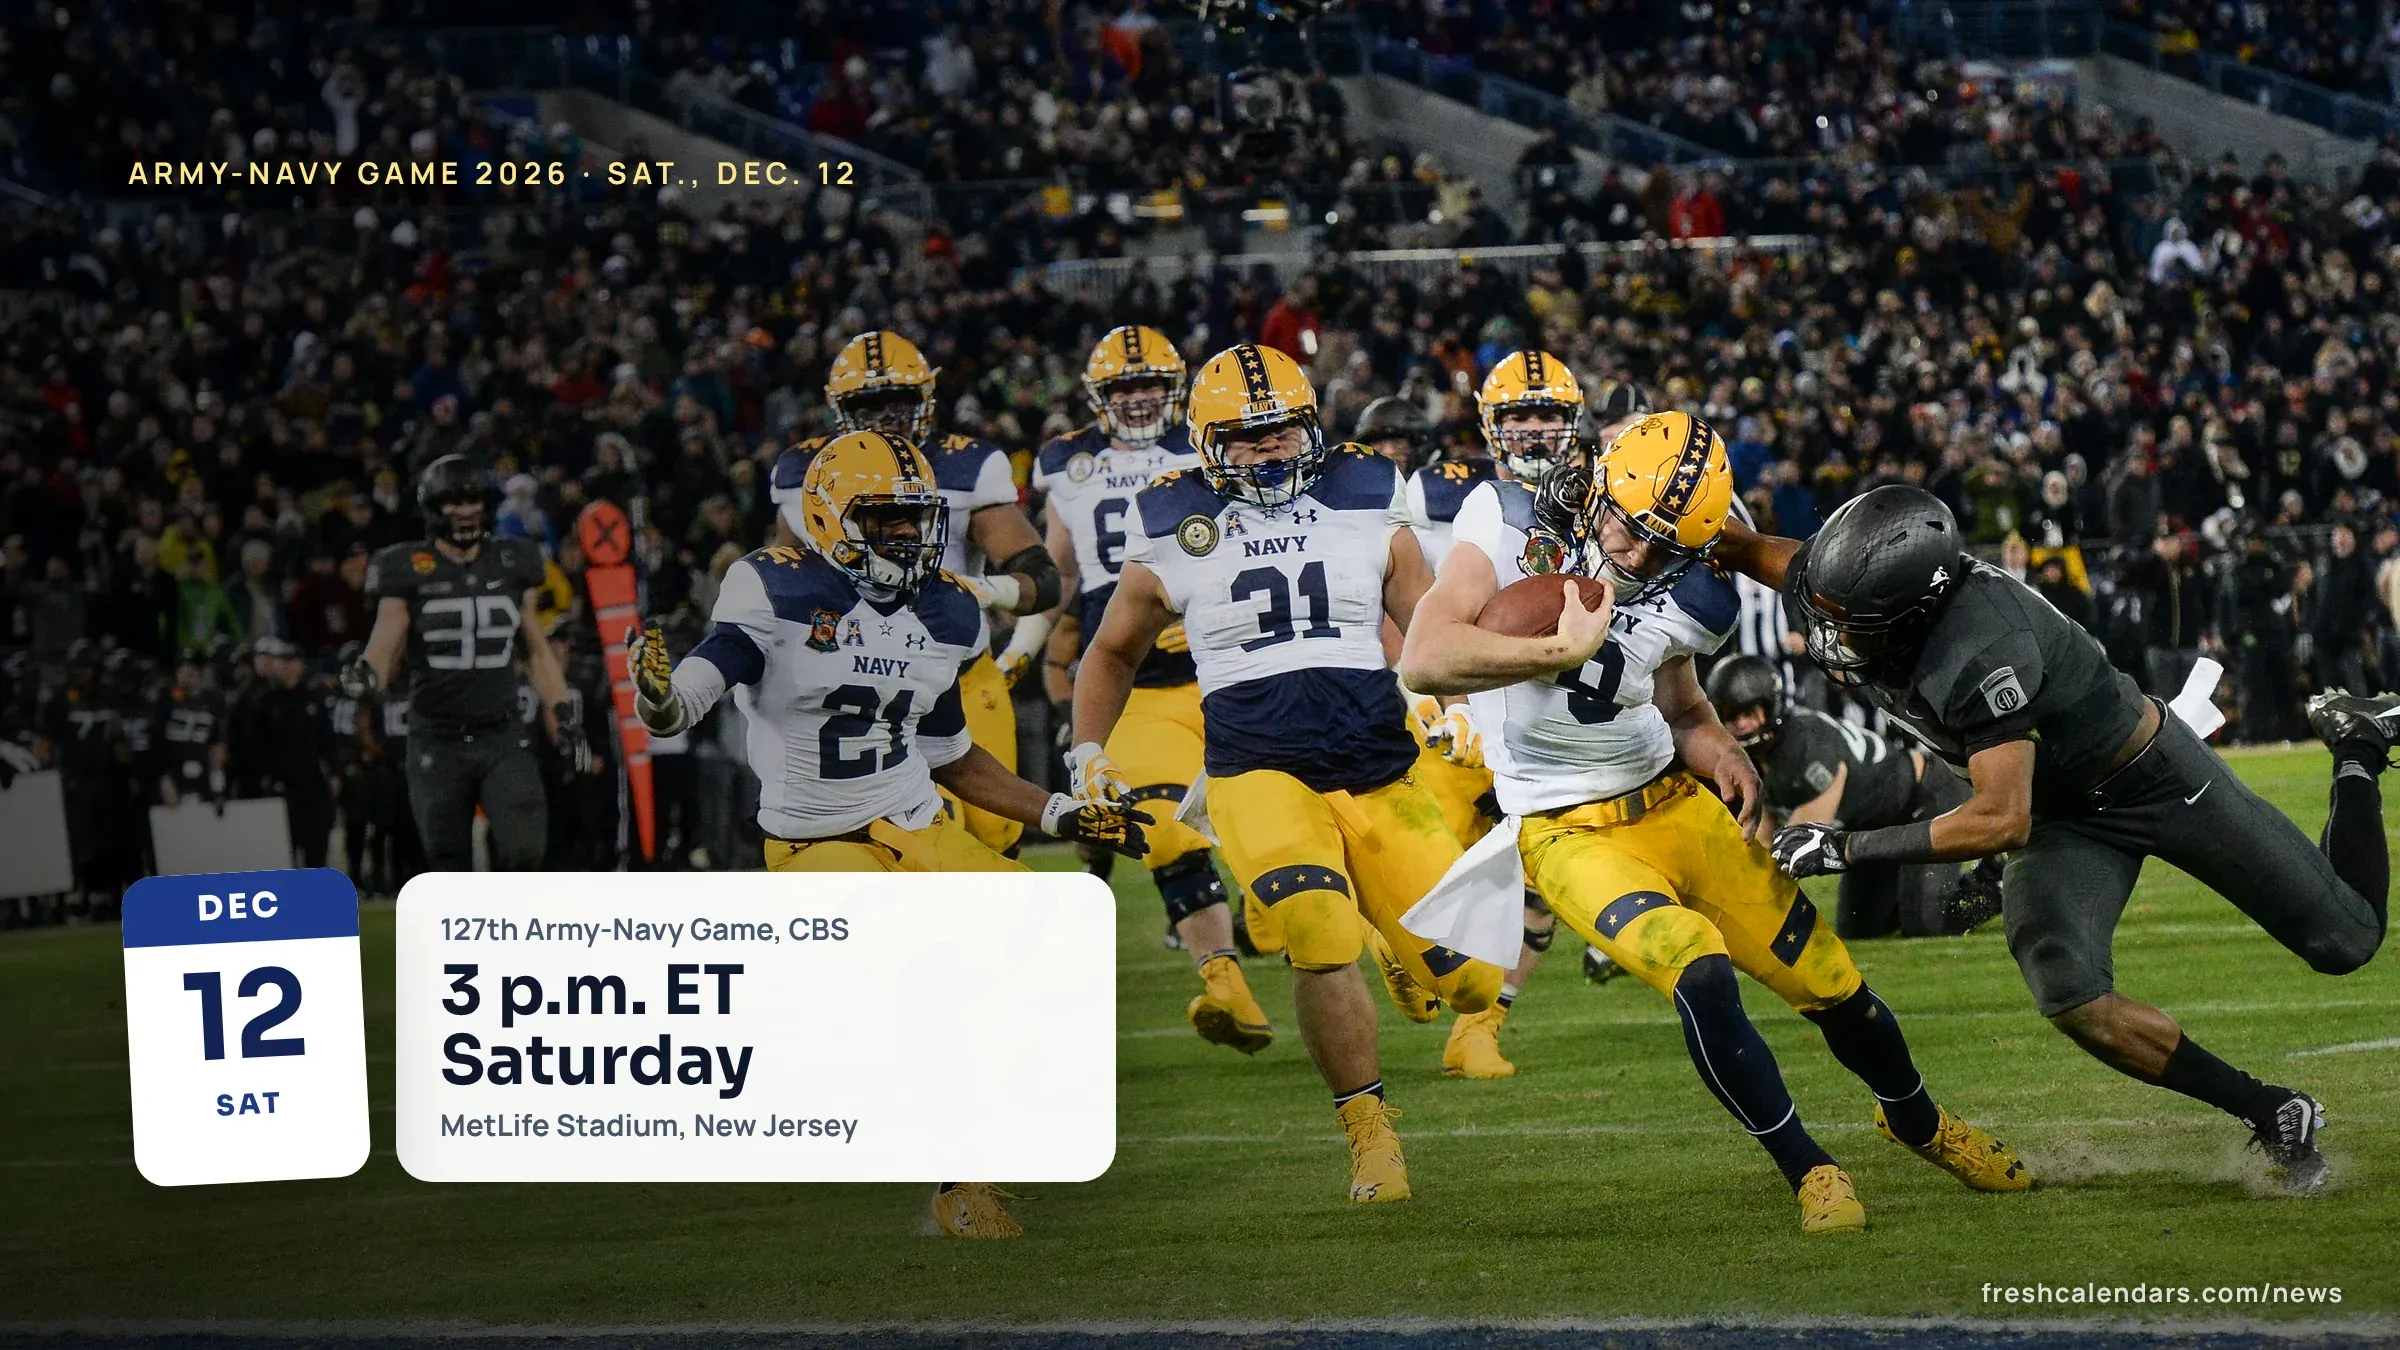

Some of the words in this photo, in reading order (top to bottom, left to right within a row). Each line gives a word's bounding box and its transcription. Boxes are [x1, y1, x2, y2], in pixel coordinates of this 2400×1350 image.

[1250, 400, 1277, 414] NAVY
[1106, 474, 1150, 490] NAVY
[1645, 515, 1673, 537] NAVY
[1243, 535, 1308, 558] NAVY
[1230, 560, 1342, 653] 31
[421, 595, 521, 669] 39
[852, 655, 910, 679] NAVY
[818, 683, 915, 779] 21
[1048, 796, 1063, 818] NAVY
